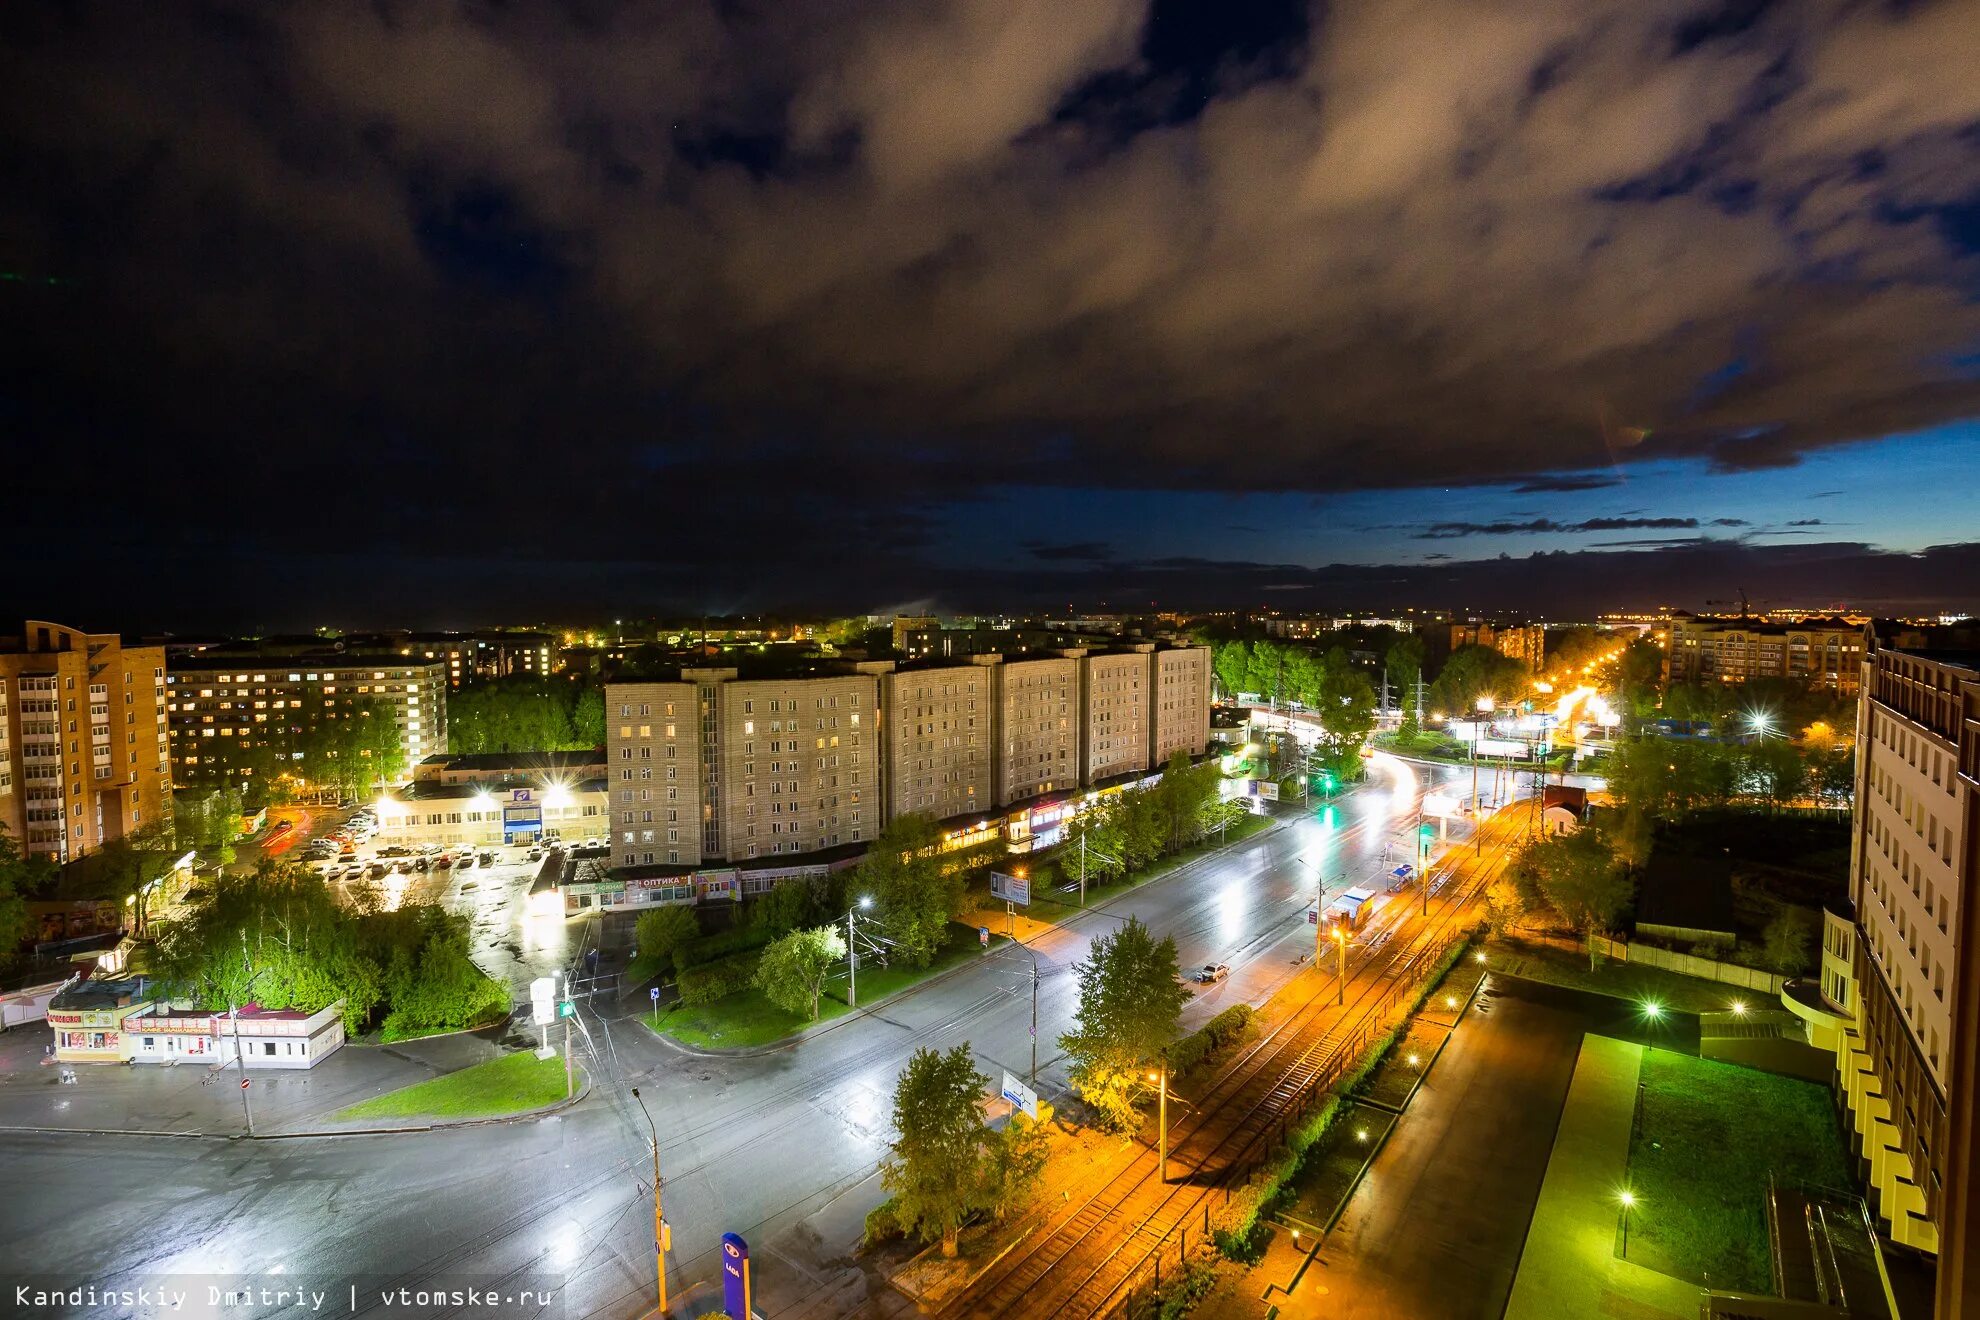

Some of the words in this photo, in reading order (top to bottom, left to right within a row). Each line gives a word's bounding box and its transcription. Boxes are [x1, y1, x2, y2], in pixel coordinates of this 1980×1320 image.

[643, 877, 680, 886] ОПТИКА
[598, 883, 624, 891] ЮЖНАЯ
[726, 1262, 740, 1278] LADA
